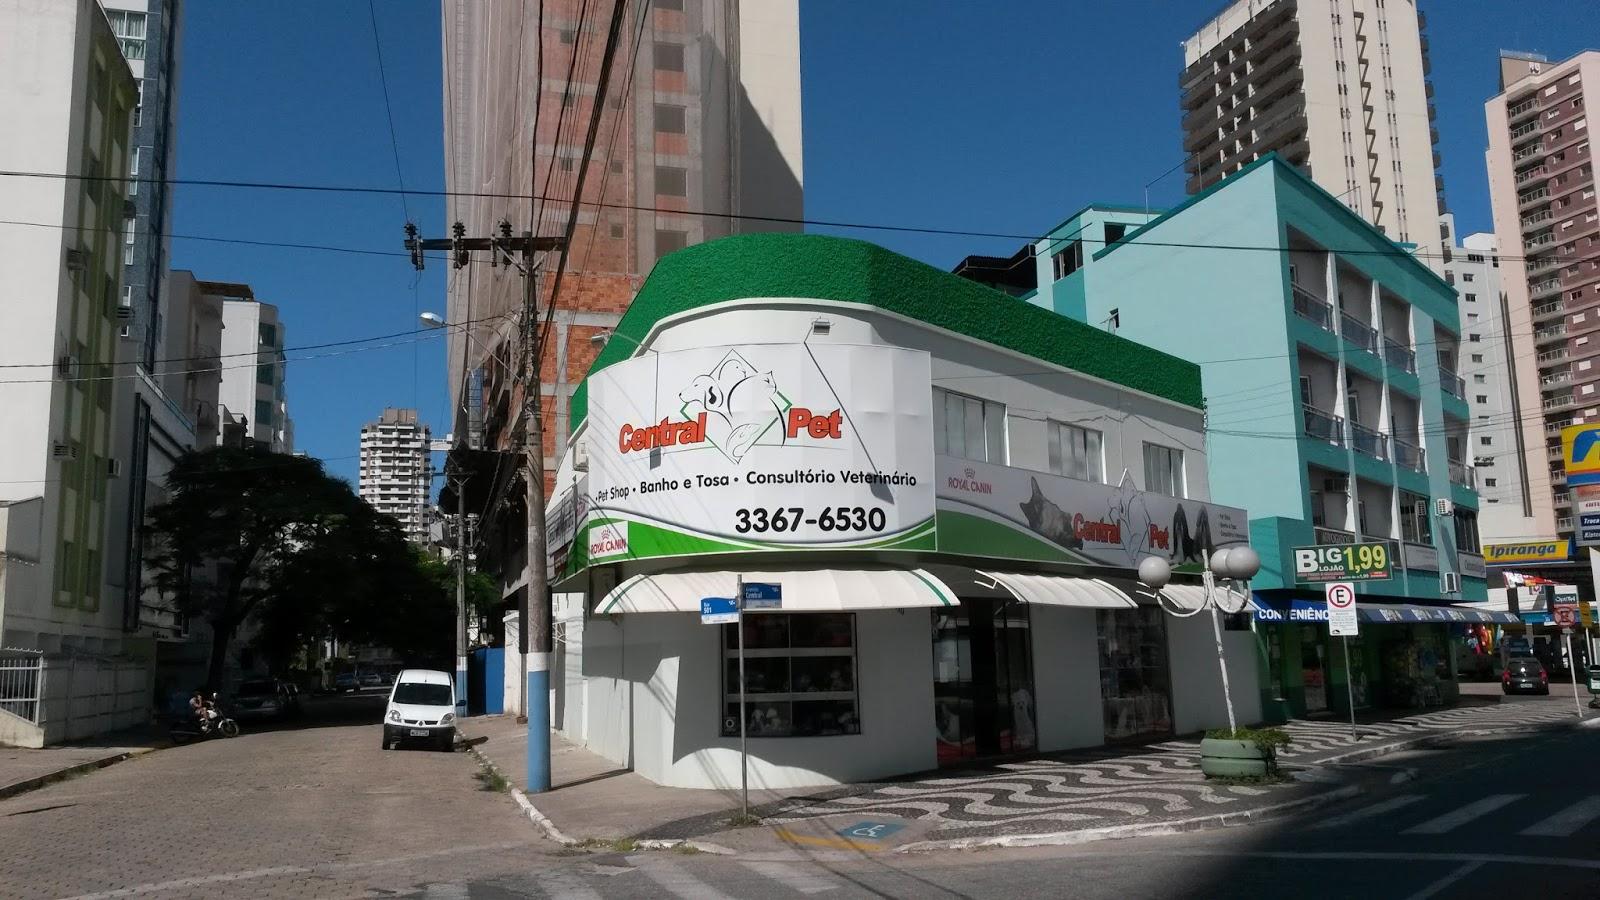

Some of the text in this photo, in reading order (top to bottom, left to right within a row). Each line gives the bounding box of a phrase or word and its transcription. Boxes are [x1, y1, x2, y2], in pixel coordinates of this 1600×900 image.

[619, 407, 843, 454] Central Pet
[610, 486, 630, 500] Shop
[640, 477, 679, 494] Banho
[683, 479, 692, 489] e
[696, 473, 730, 488] Tosa
[746, 469, 836, 485] Consultório
[840, 470, 917, 487] Veterinário
[948, 476, 992, 495] ROYAL CANIN
[735, 507, 886, 533] 3367-6530
[1073, 512, 1170, 550] Central Pet
[591, 538, 627, 555] ROYAL CANIN
[1490, 544, 1557, 558] Ipiranga
[1295, 545, 1387, 573] BIG 1,99
[1319, 564, 1344, 572] LOJÃO
[1336, 589, 1346, 603] E
